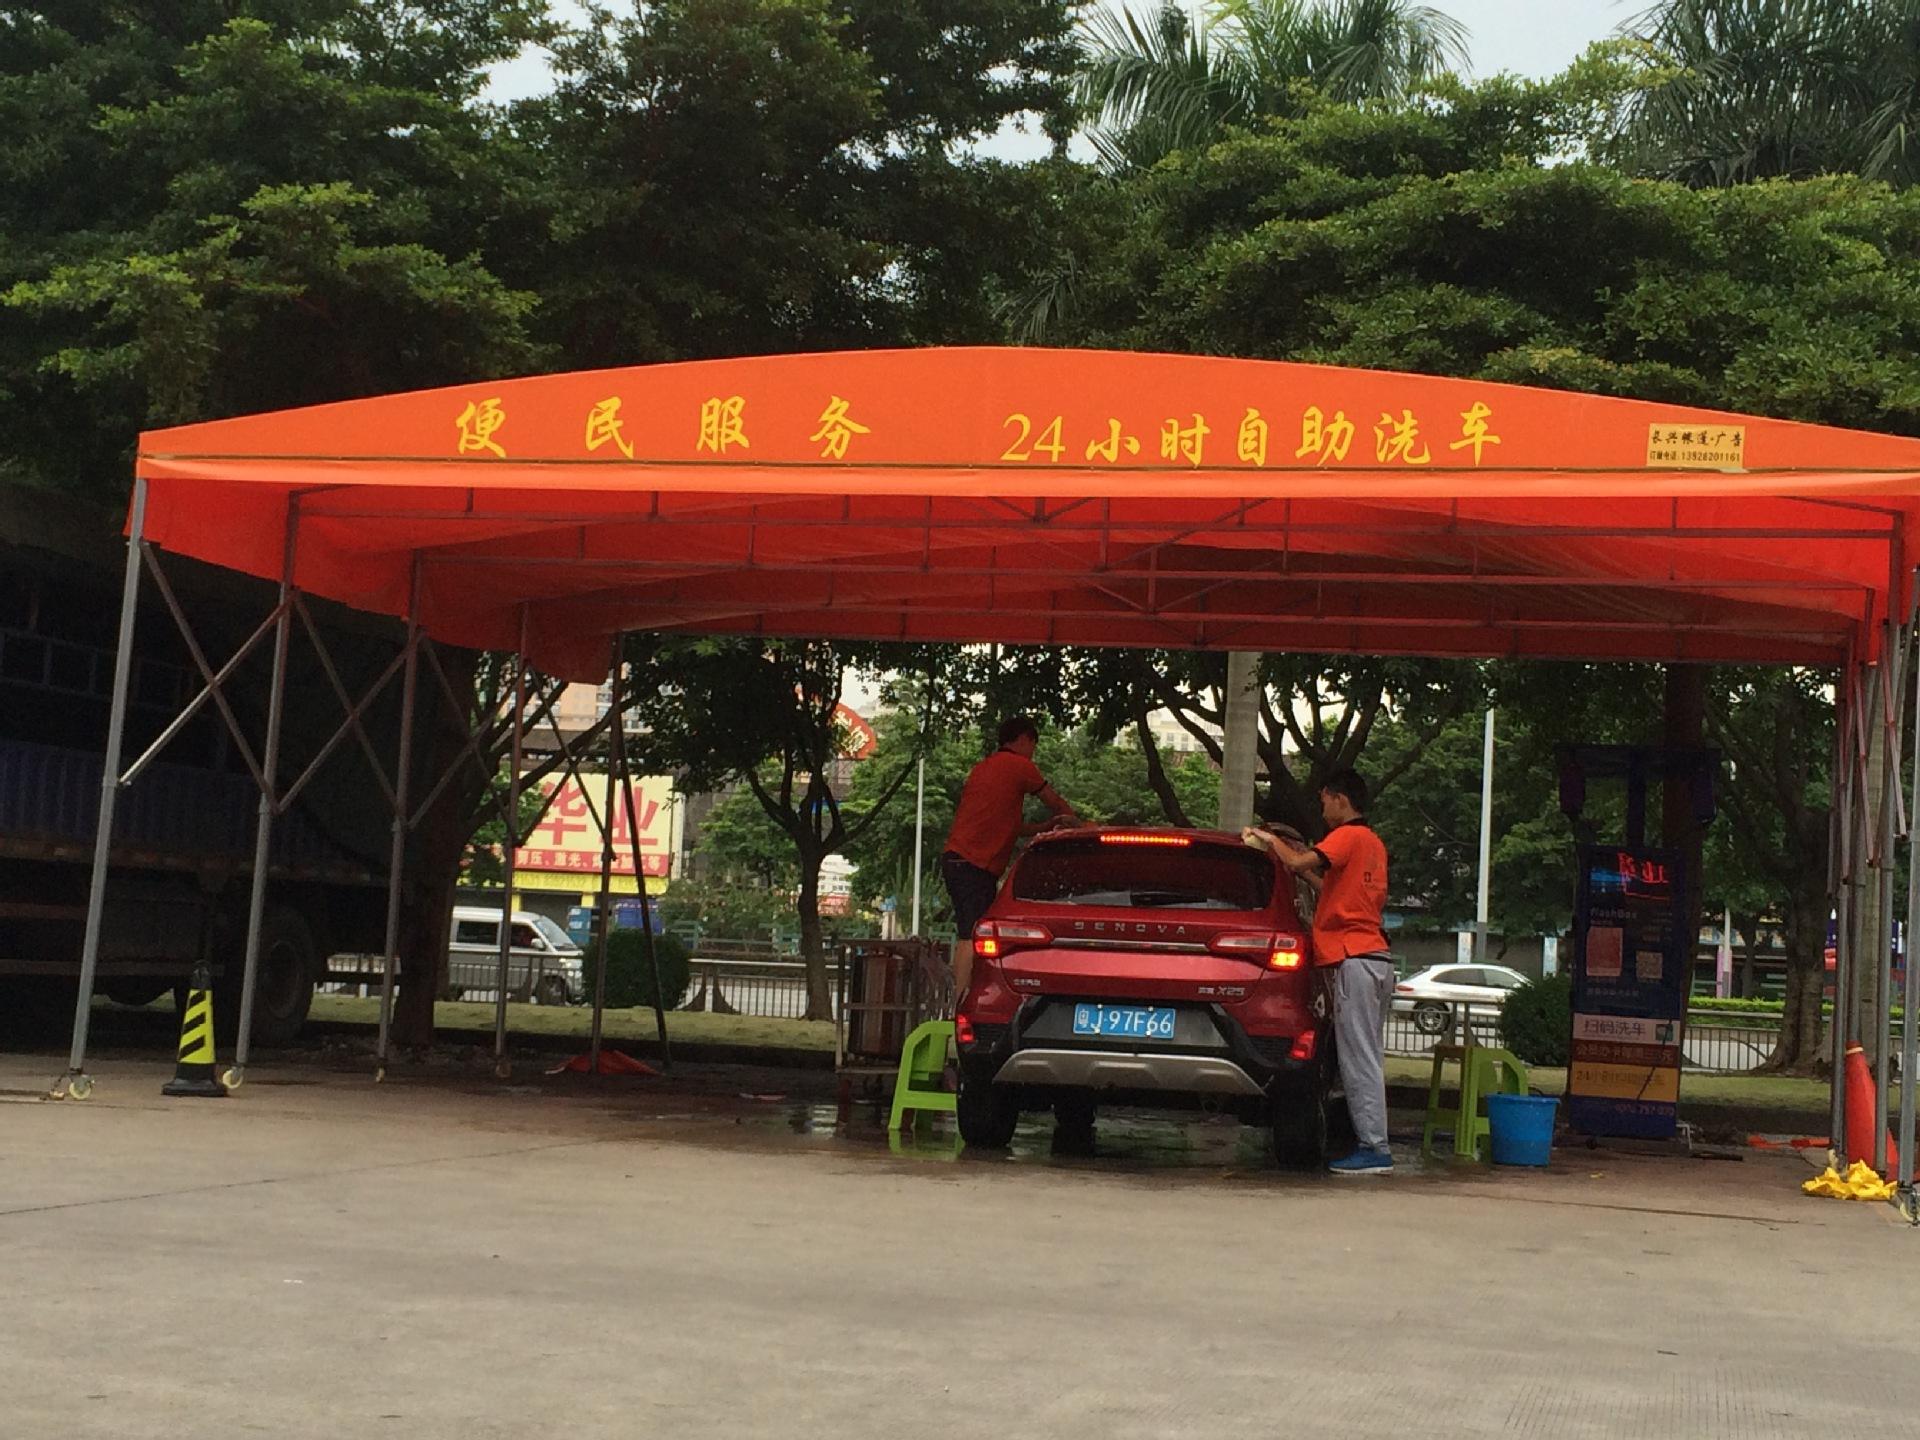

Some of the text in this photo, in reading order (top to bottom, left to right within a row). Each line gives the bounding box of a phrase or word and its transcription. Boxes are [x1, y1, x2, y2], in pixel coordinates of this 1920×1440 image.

[455, 396, 870, 459] 便民服务
[535, 781, 659, 845] 华业
[1074, 920, 1187, 935] SENOVA
[1584, 1019, 1646, 1036] 扫码洗车
